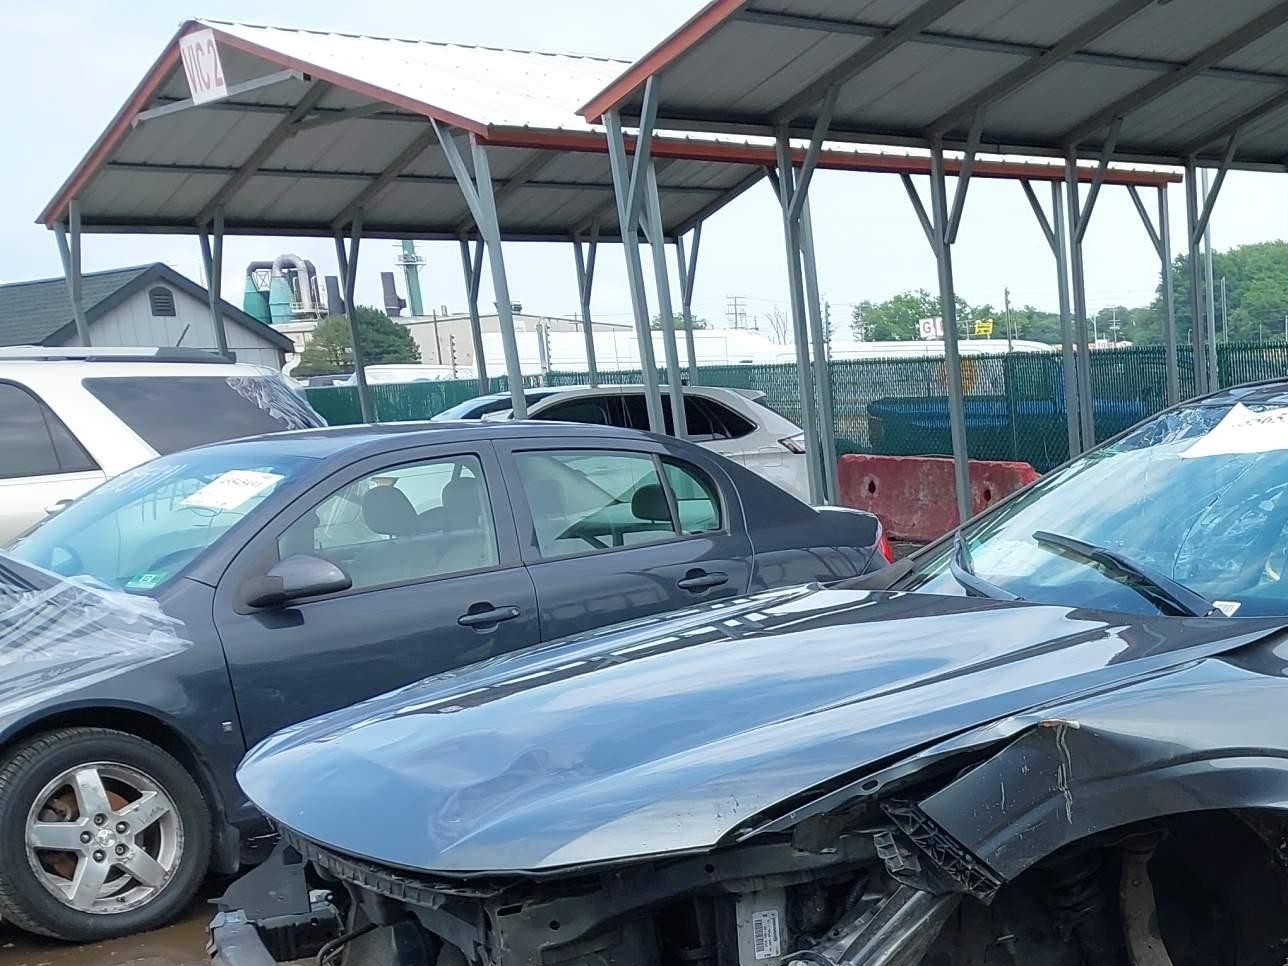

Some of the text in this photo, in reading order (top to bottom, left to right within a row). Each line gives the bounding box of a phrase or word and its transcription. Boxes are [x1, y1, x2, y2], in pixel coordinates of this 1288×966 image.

[182, 38, 224, 93] VIC 2
[922, 321, 931, 334] G
